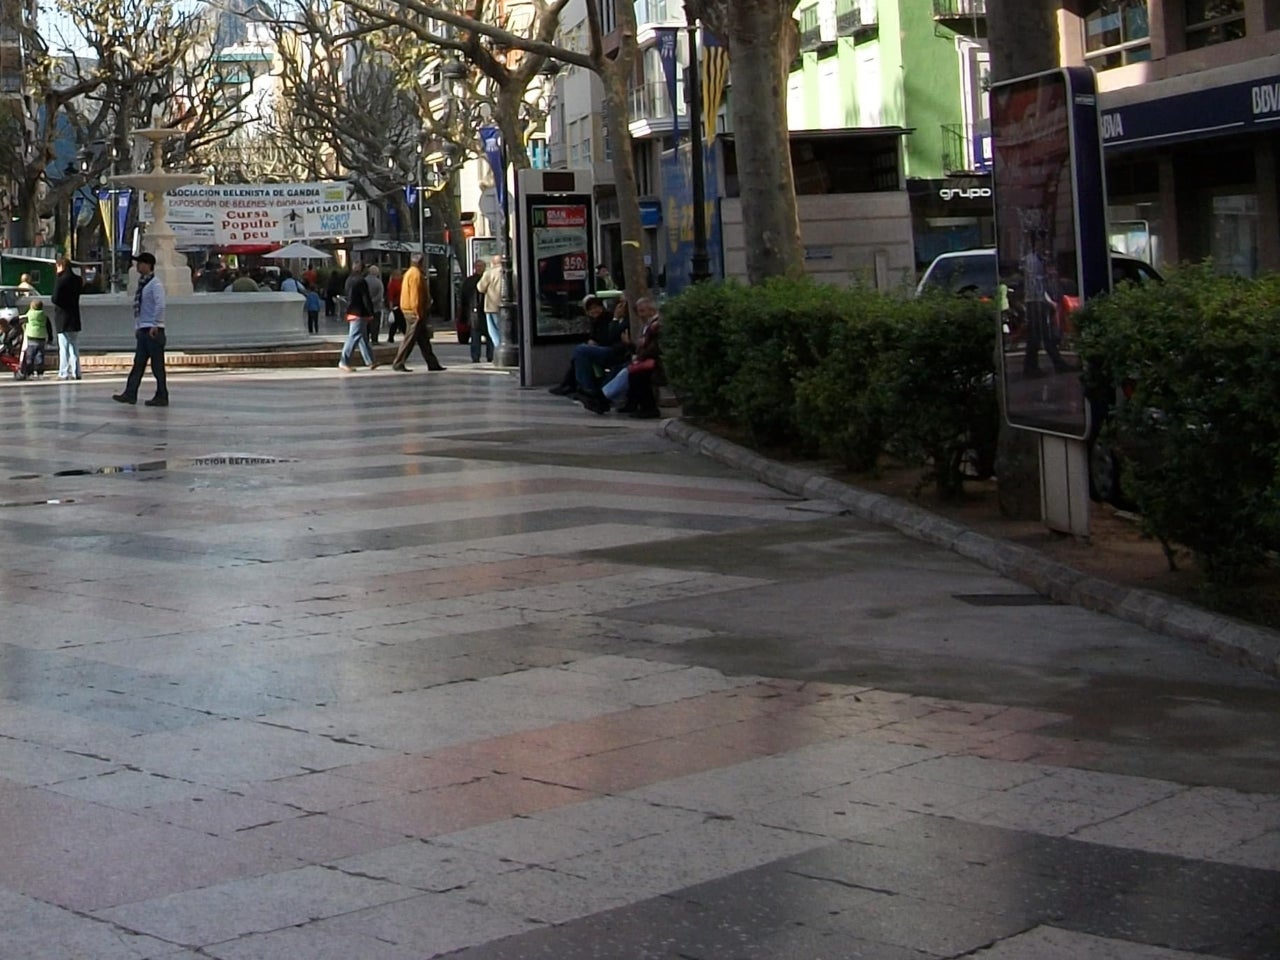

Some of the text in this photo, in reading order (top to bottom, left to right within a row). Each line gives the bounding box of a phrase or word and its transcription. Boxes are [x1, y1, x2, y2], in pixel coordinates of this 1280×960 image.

[223, 189, 270, 197] BELENISTA
[273, 189, 285, 197] DE
[939, 186, 991, 201] grupo
[219, 199, 230, 208] DE
[306, 203, 363, 214] MEMORIAL
[227, 210, 269, 220] Cursa
[319, 212, 351, 222] Vicent
[222, 219, 280, 230] Popular
[230, 231, 269, 241] a peu
